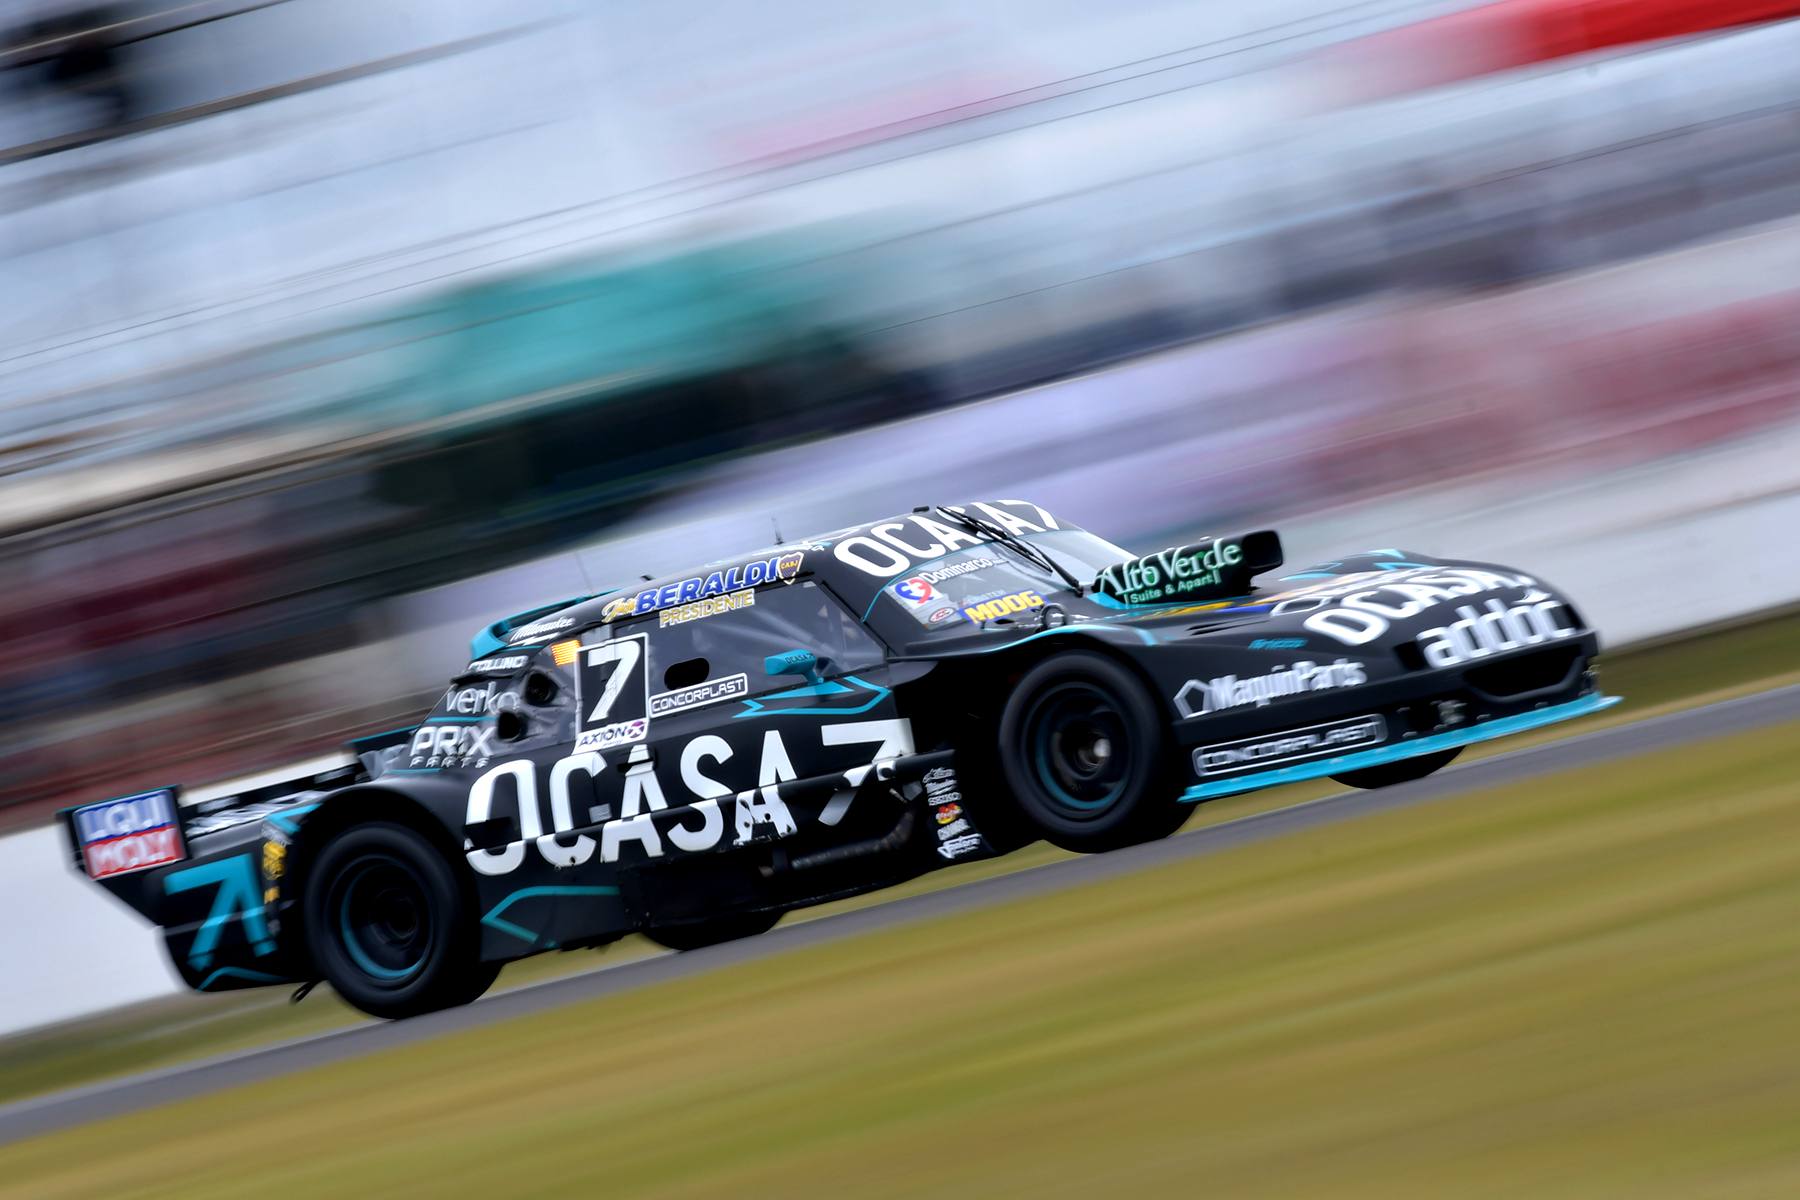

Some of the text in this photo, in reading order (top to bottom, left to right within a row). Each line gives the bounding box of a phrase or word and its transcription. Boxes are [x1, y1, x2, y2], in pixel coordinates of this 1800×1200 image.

[918, 558, 993, 585] Dommarco
[1155, 538, 1243, 580] Verde
[632, 557, 781, 616] BERALDI
[1130, 573, 1215, 604] Suite & Apart
[660, 589, 755, 628] PRESIDENTE
[964, 590, 1044, 625] MOOG
[587, 640, 641, 723] 7
[651, 679, 744, 713] CONCORPLAST
[578, 726, 628, 747] AXION
